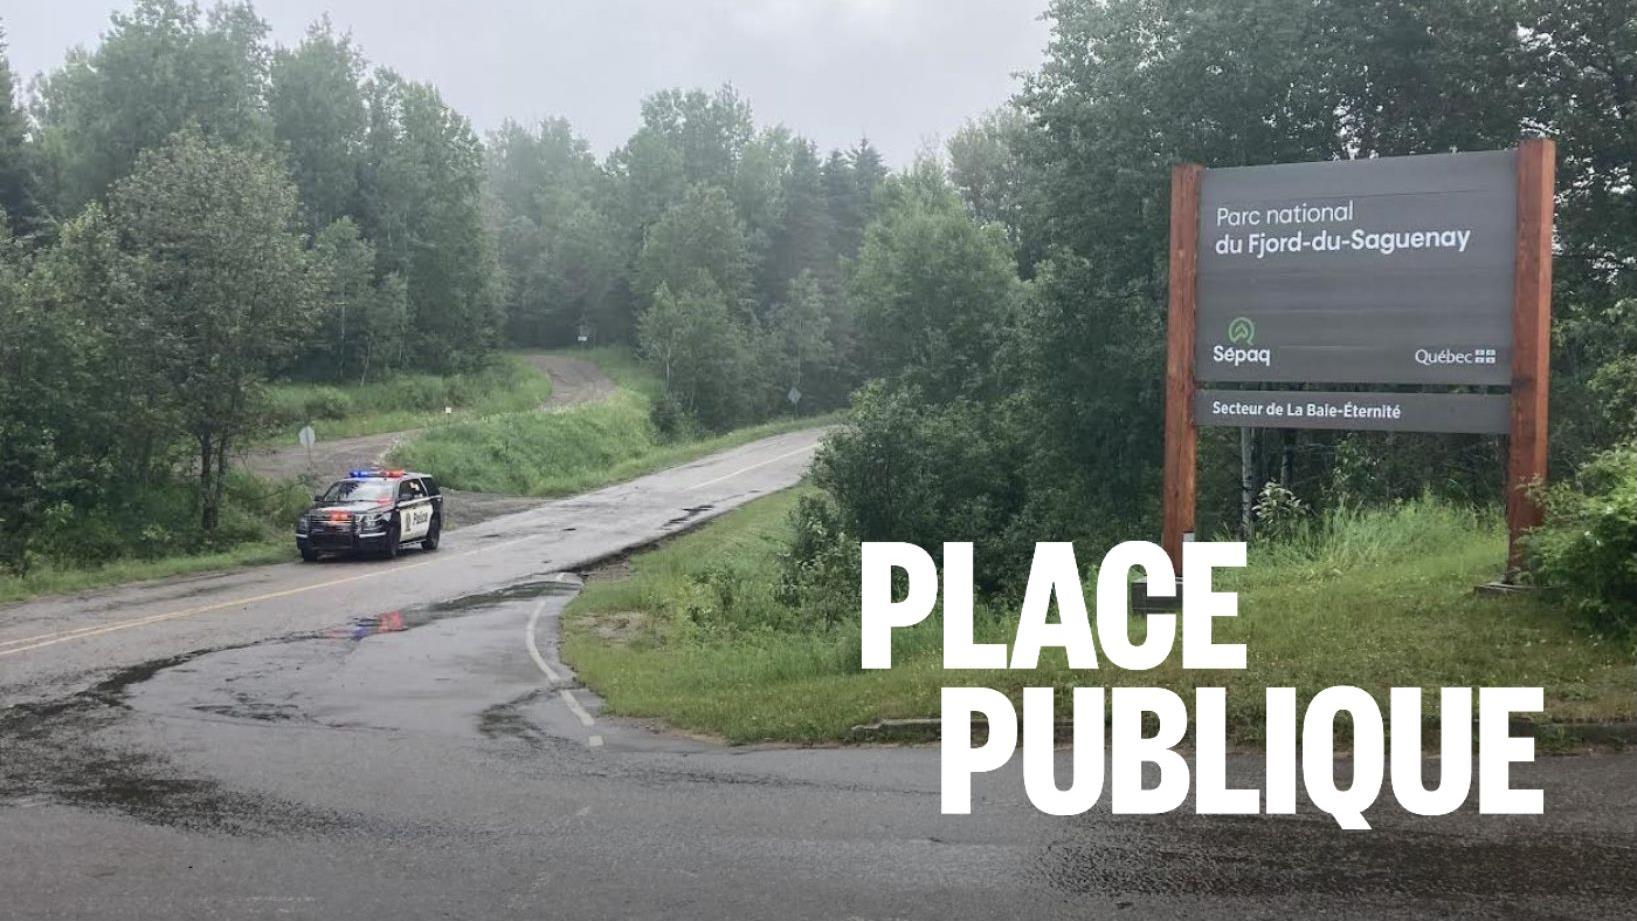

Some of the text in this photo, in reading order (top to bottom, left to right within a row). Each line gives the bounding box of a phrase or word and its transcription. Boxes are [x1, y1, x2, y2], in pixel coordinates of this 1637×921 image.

[1216, 199, 1354, 227] Parc national
[1215, 228, 1472, 259] du Fjord-du-Saguenay
[1212, 345, 1271, 367] Sépaq
[1414, 348, 1474, 366] Québec
[1212, 400, 1402, 419] Secteur de La Baie-Éternité
